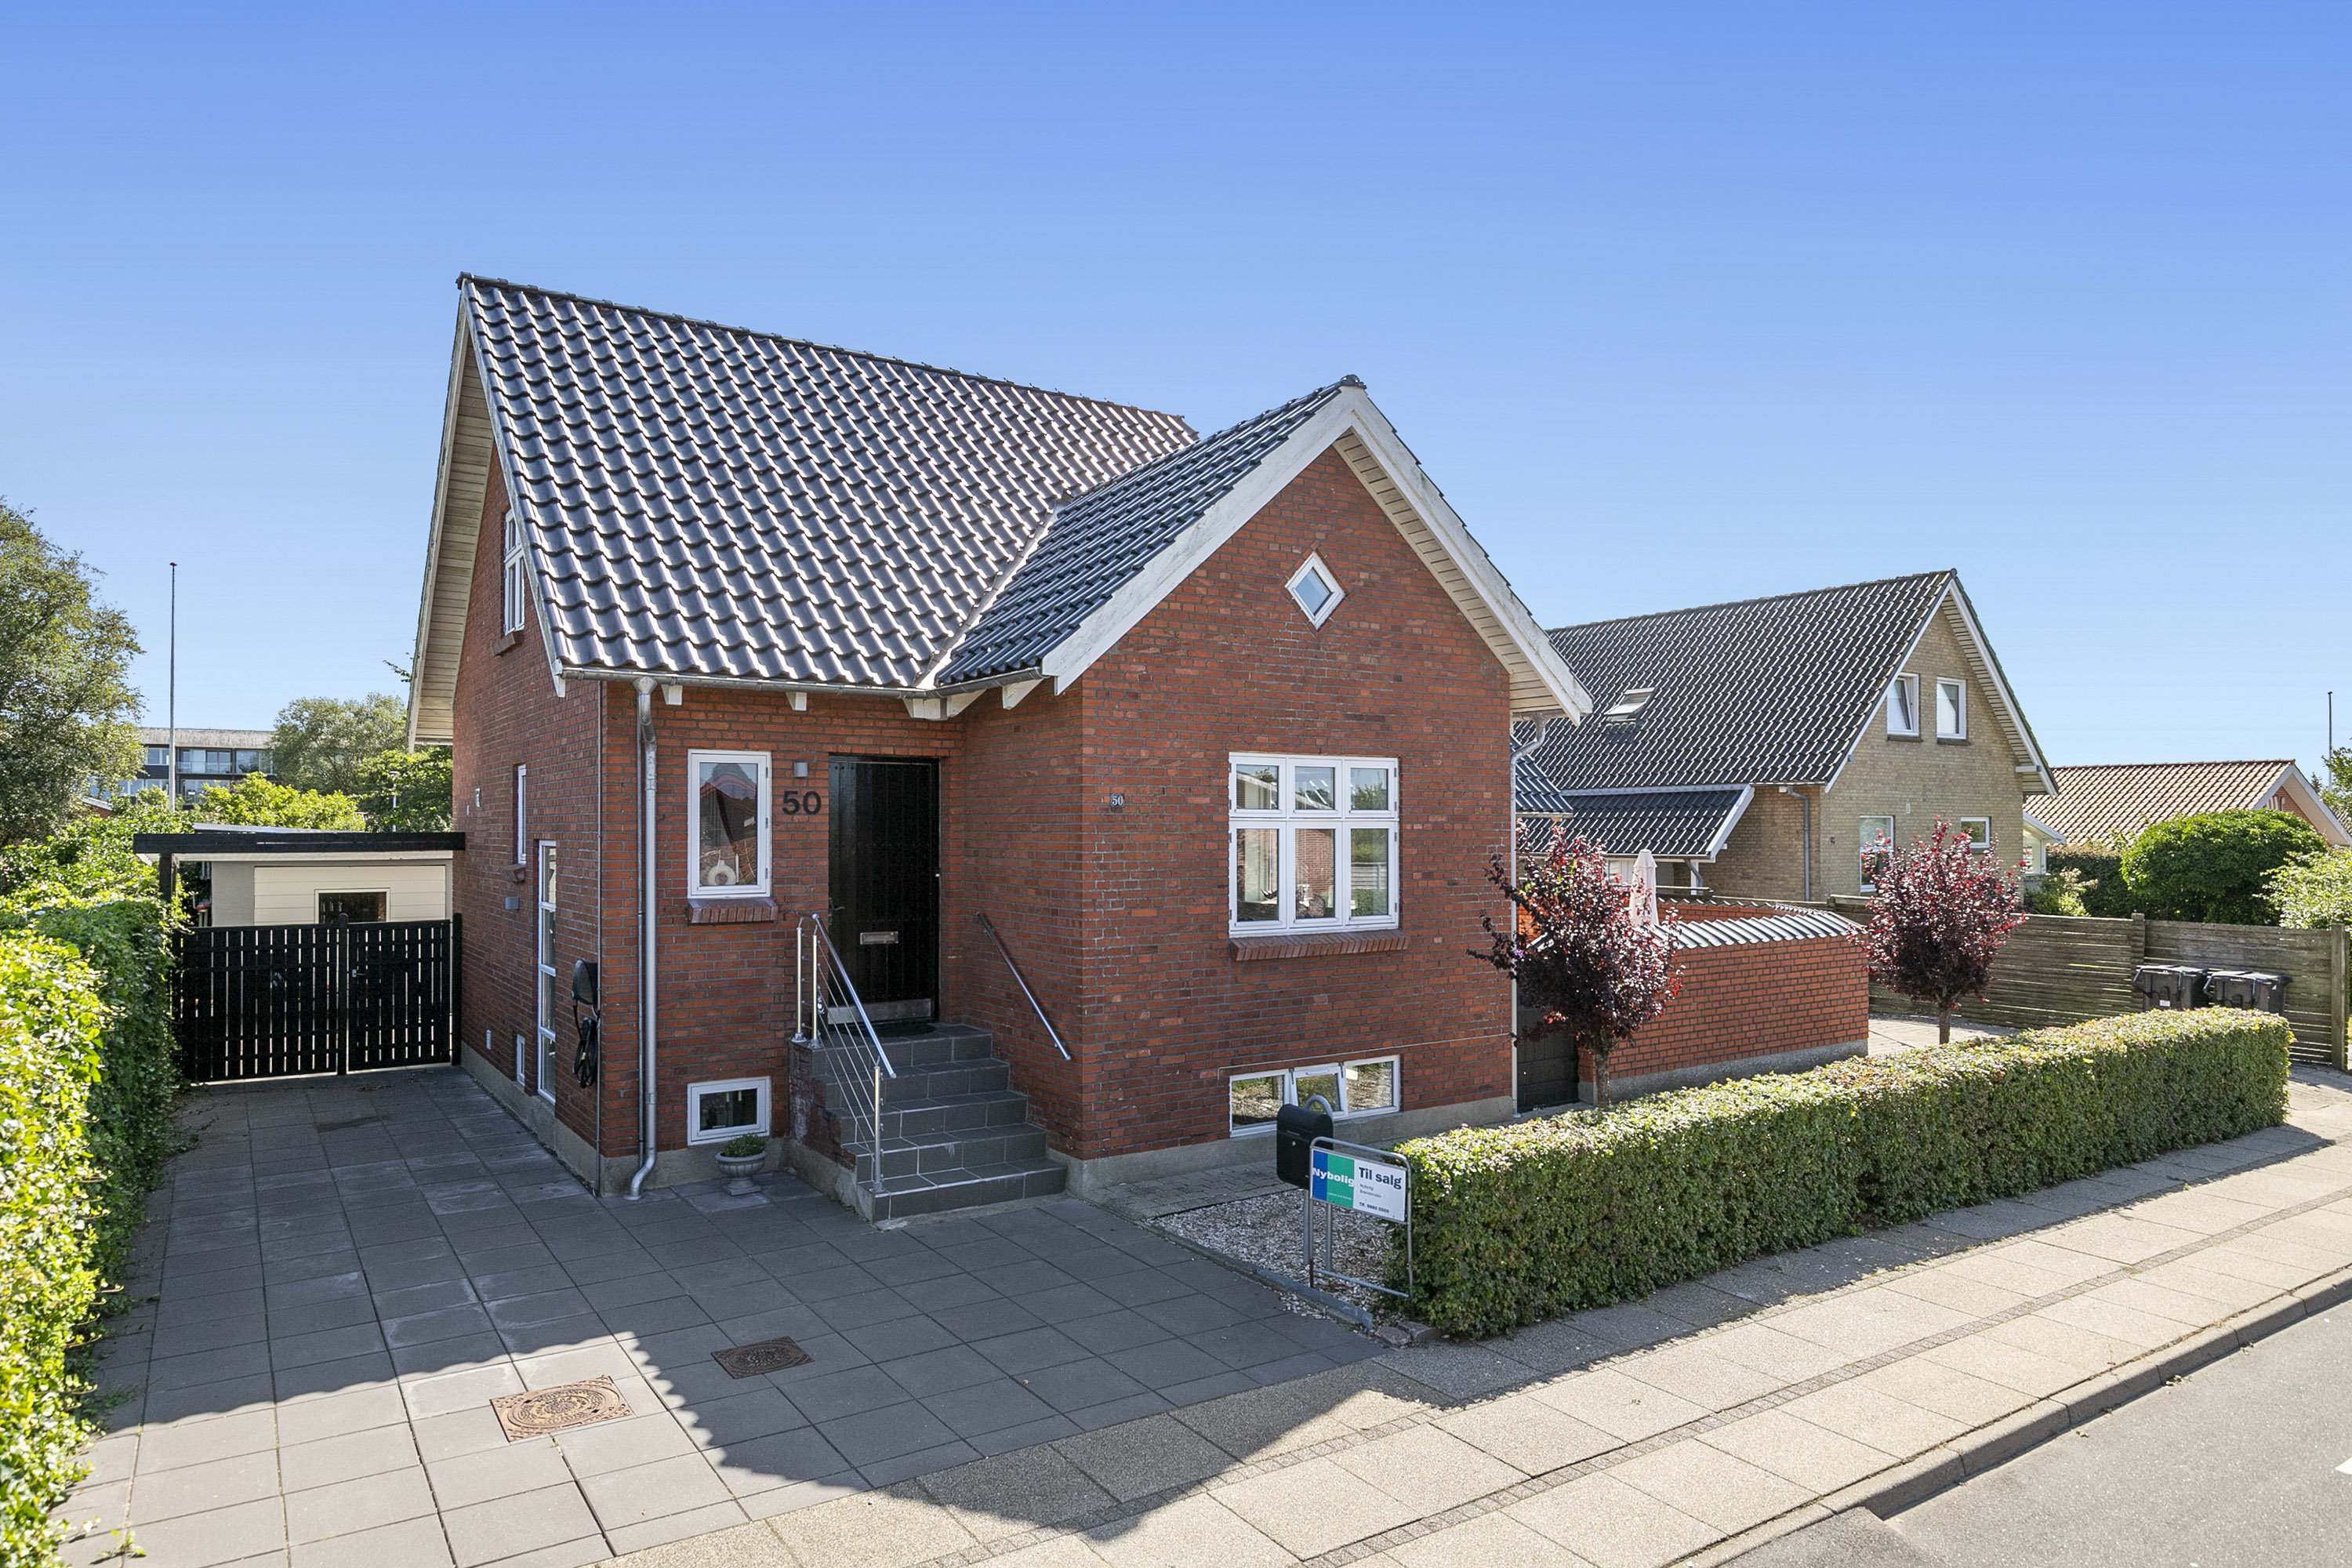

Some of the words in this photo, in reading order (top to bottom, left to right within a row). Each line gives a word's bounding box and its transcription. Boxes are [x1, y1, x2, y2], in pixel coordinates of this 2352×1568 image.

[782, 790, 822, 815] 50
[1112, 795, 1123, 806] 50
[1312, 1167, 1354, 1187] Nybolig
[1359, 1167, 1372, 1180] Til
[1375, 1173, 1402, 1189] salg
